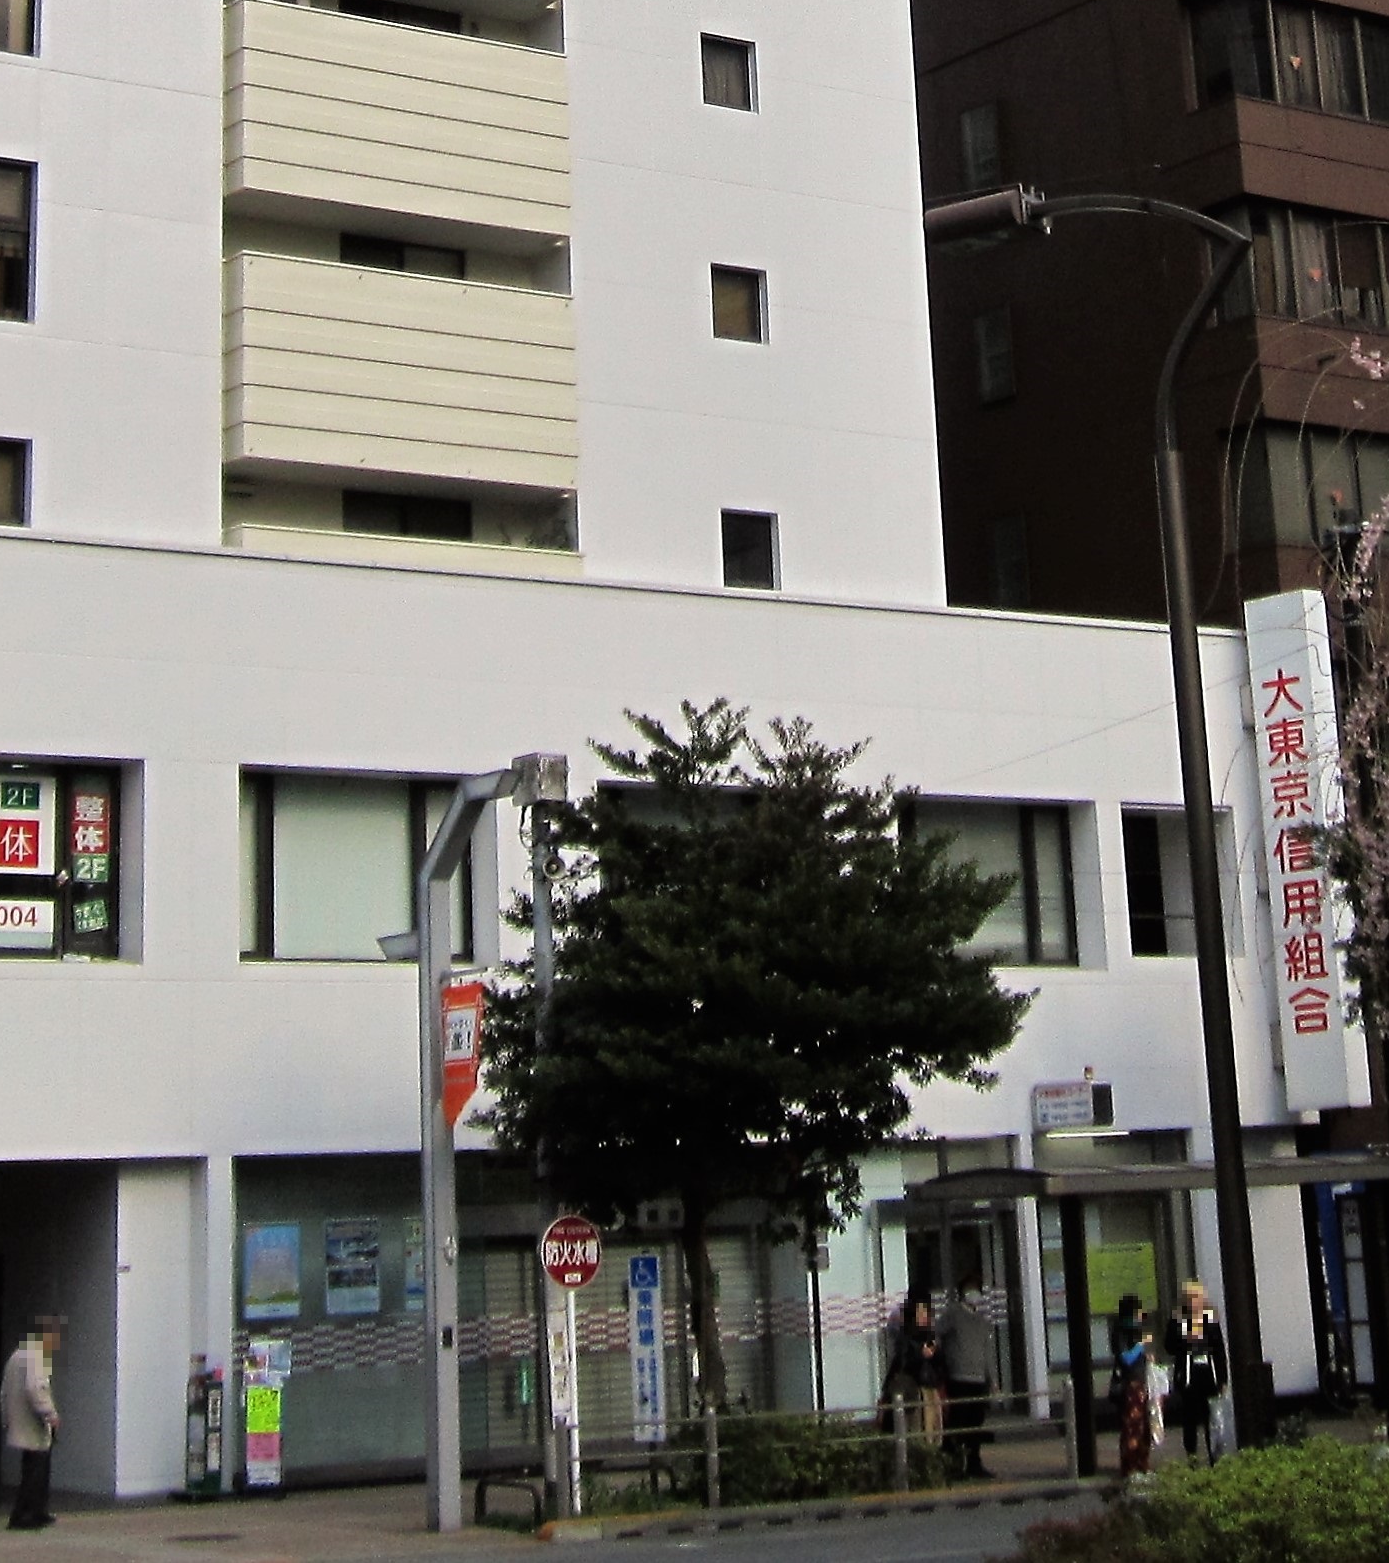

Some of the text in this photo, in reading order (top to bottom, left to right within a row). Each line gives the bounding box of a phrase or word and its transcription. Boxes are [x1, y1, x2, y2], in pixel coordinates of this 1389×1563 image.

[7, 787, 36, 806] 2F
[74, 794, 109, 854] 整体
[76, 857, 108, 881] 2F
[1261, 668, 1331, 1035] 大東京信用組合
